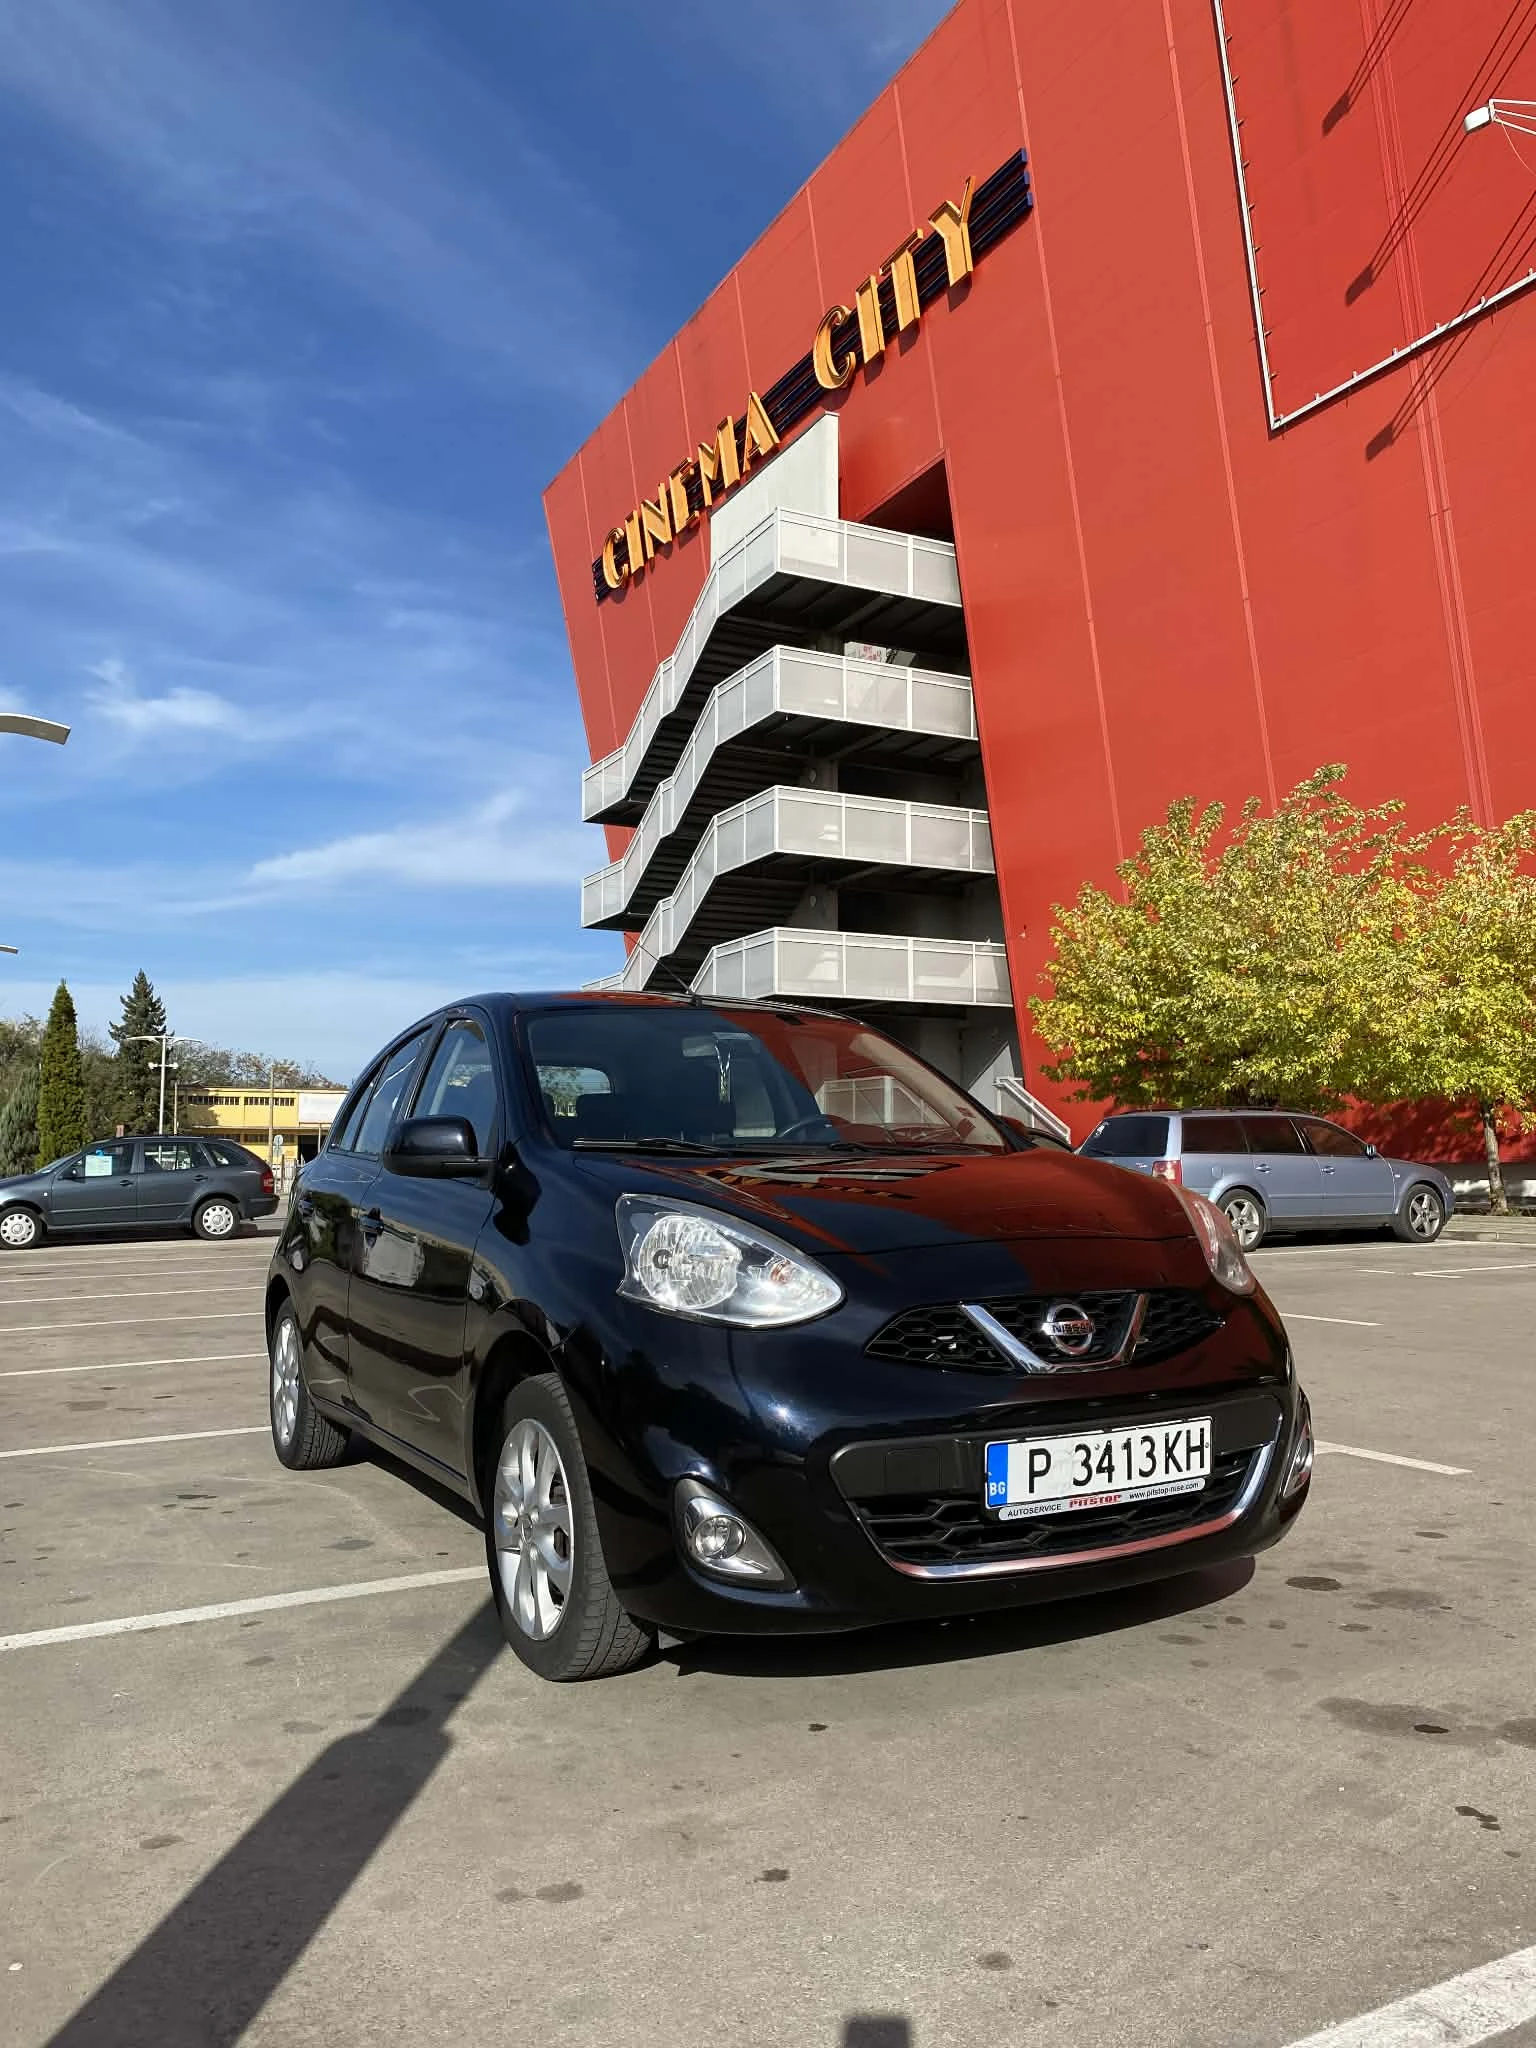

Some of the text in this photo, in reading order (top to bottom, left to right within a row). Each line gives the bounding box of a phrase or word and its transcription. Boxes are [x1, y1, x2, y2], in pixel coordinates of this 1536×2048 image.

[603, 175, 976, 588] CINEMA CITY
[1029, 1448, 1052, 1493] P
[989, 1481, 1006, 1496] BG
[1007, 1503, 1062, 1518] AUTOSERVICE
[1068, 1494, 1122, 1508] PITSTOP
